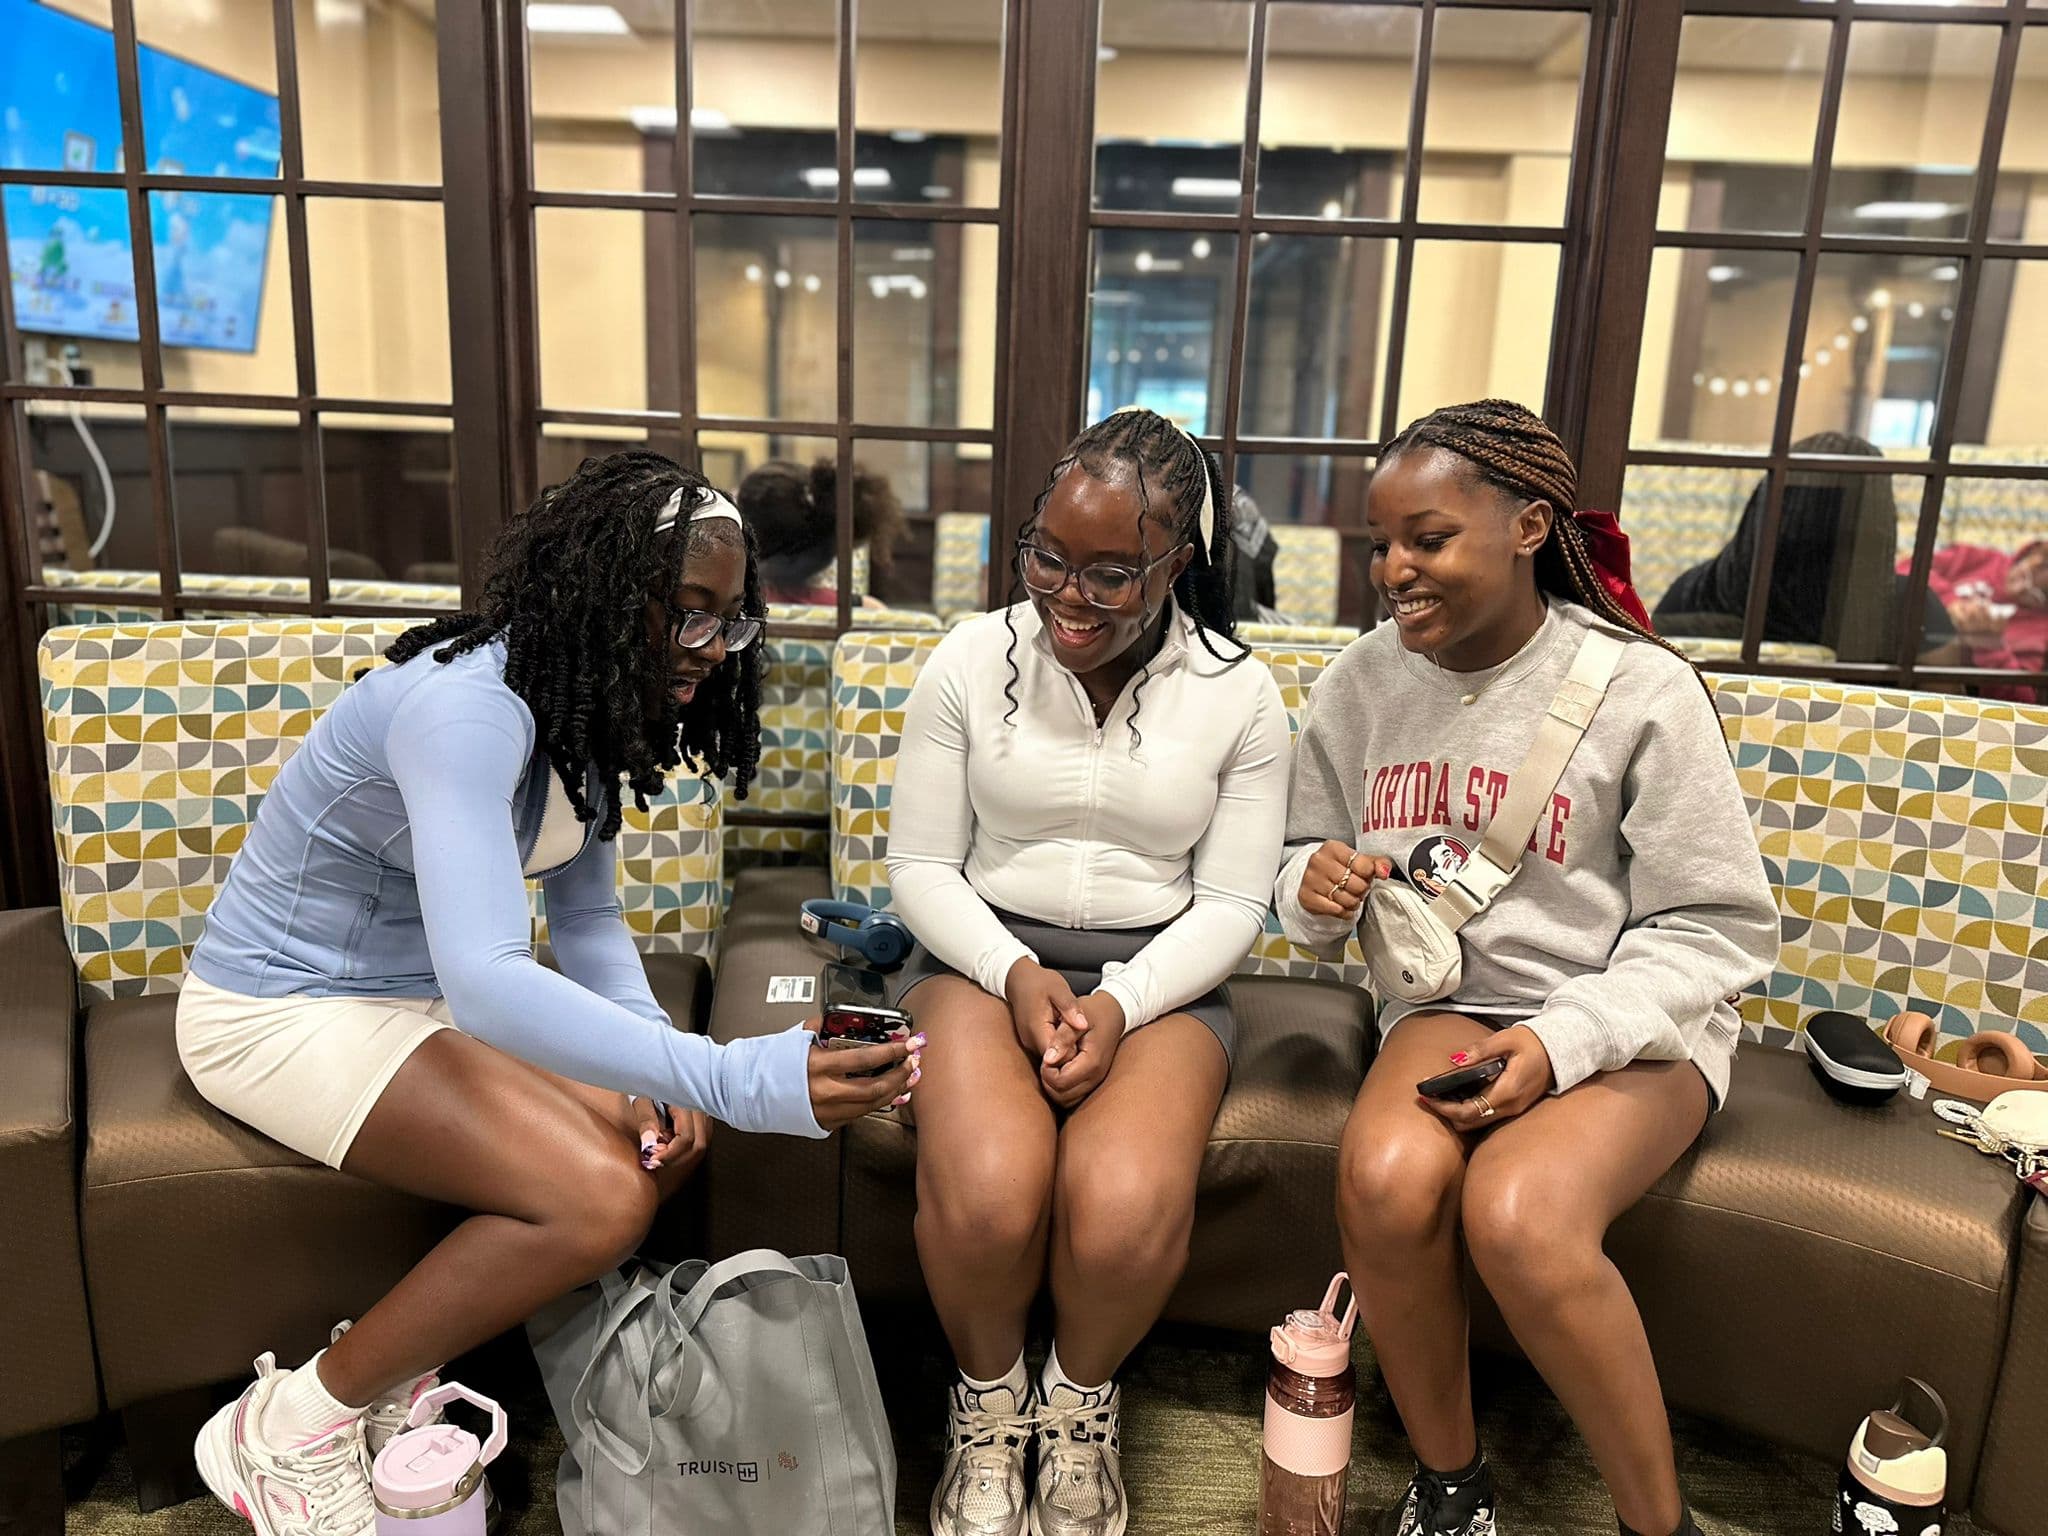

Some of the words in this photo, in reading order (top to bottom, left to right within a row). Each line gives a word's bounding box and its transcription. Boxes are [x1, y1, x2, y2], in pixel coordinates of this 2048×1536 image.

[1362, 761, 1451, 834] LORIDA
[1463, 766, 1571, 865] STE
[677, 1460, 735, 1476] TRUIST
